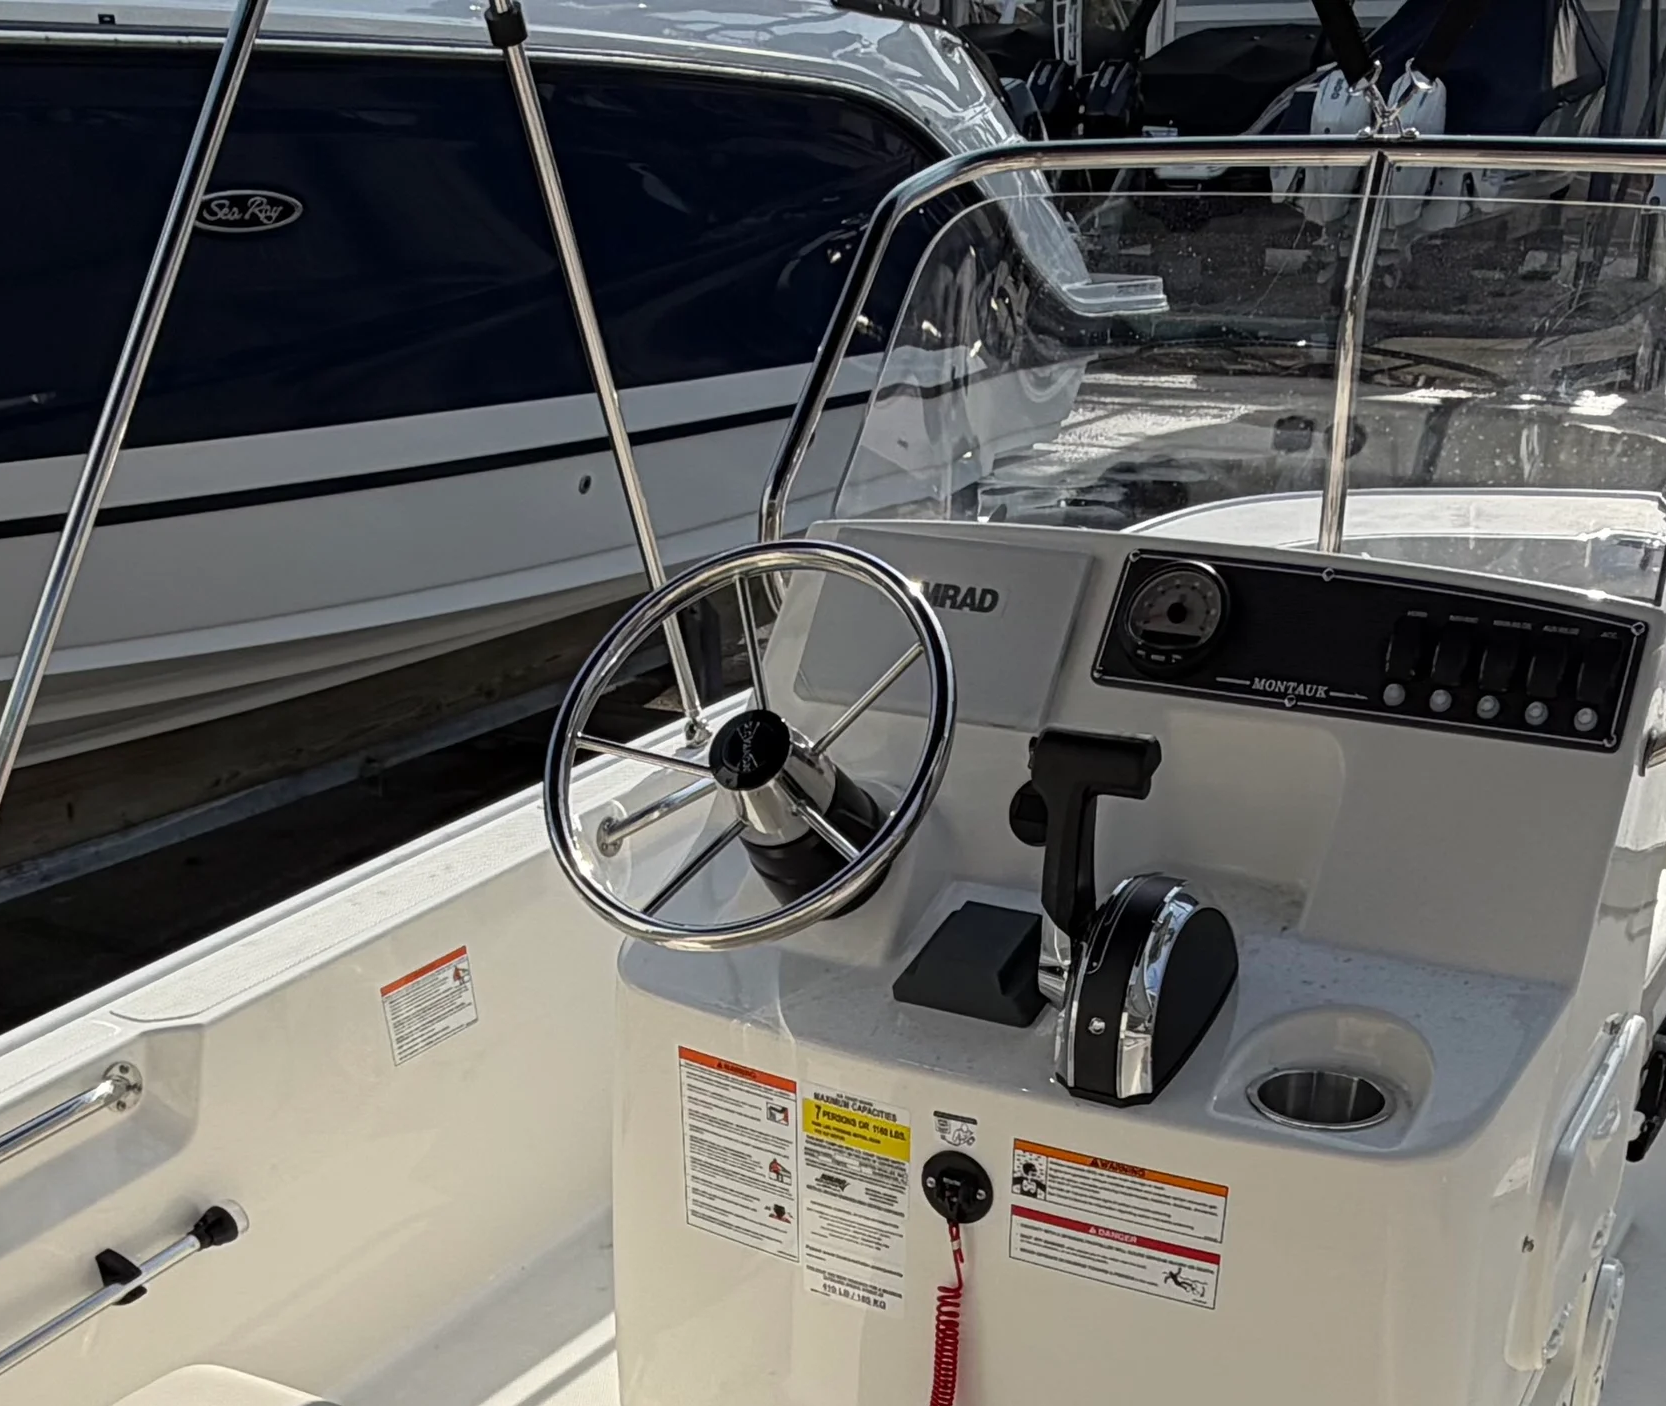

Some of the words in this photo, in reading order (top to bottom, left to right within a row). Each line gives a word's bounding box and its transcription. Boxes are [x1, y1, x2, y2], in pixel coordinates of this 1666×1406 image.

[202, 199, 243, 221] Sea
[244, 196, 283, 224] Ray
[919, 580, 999, 613] MRAD
[1251, 677, 1329, 698] MONTAUK
[814, 1104, 822, 1120] 7
[822, 1110, 857, 1128] PERSONS
[851, 1101, 897, 1123] CAPACITIES
[1098, 1159, 1146, 1178] WARNING
[1098, 1228, 1137, 1244] DANGER
